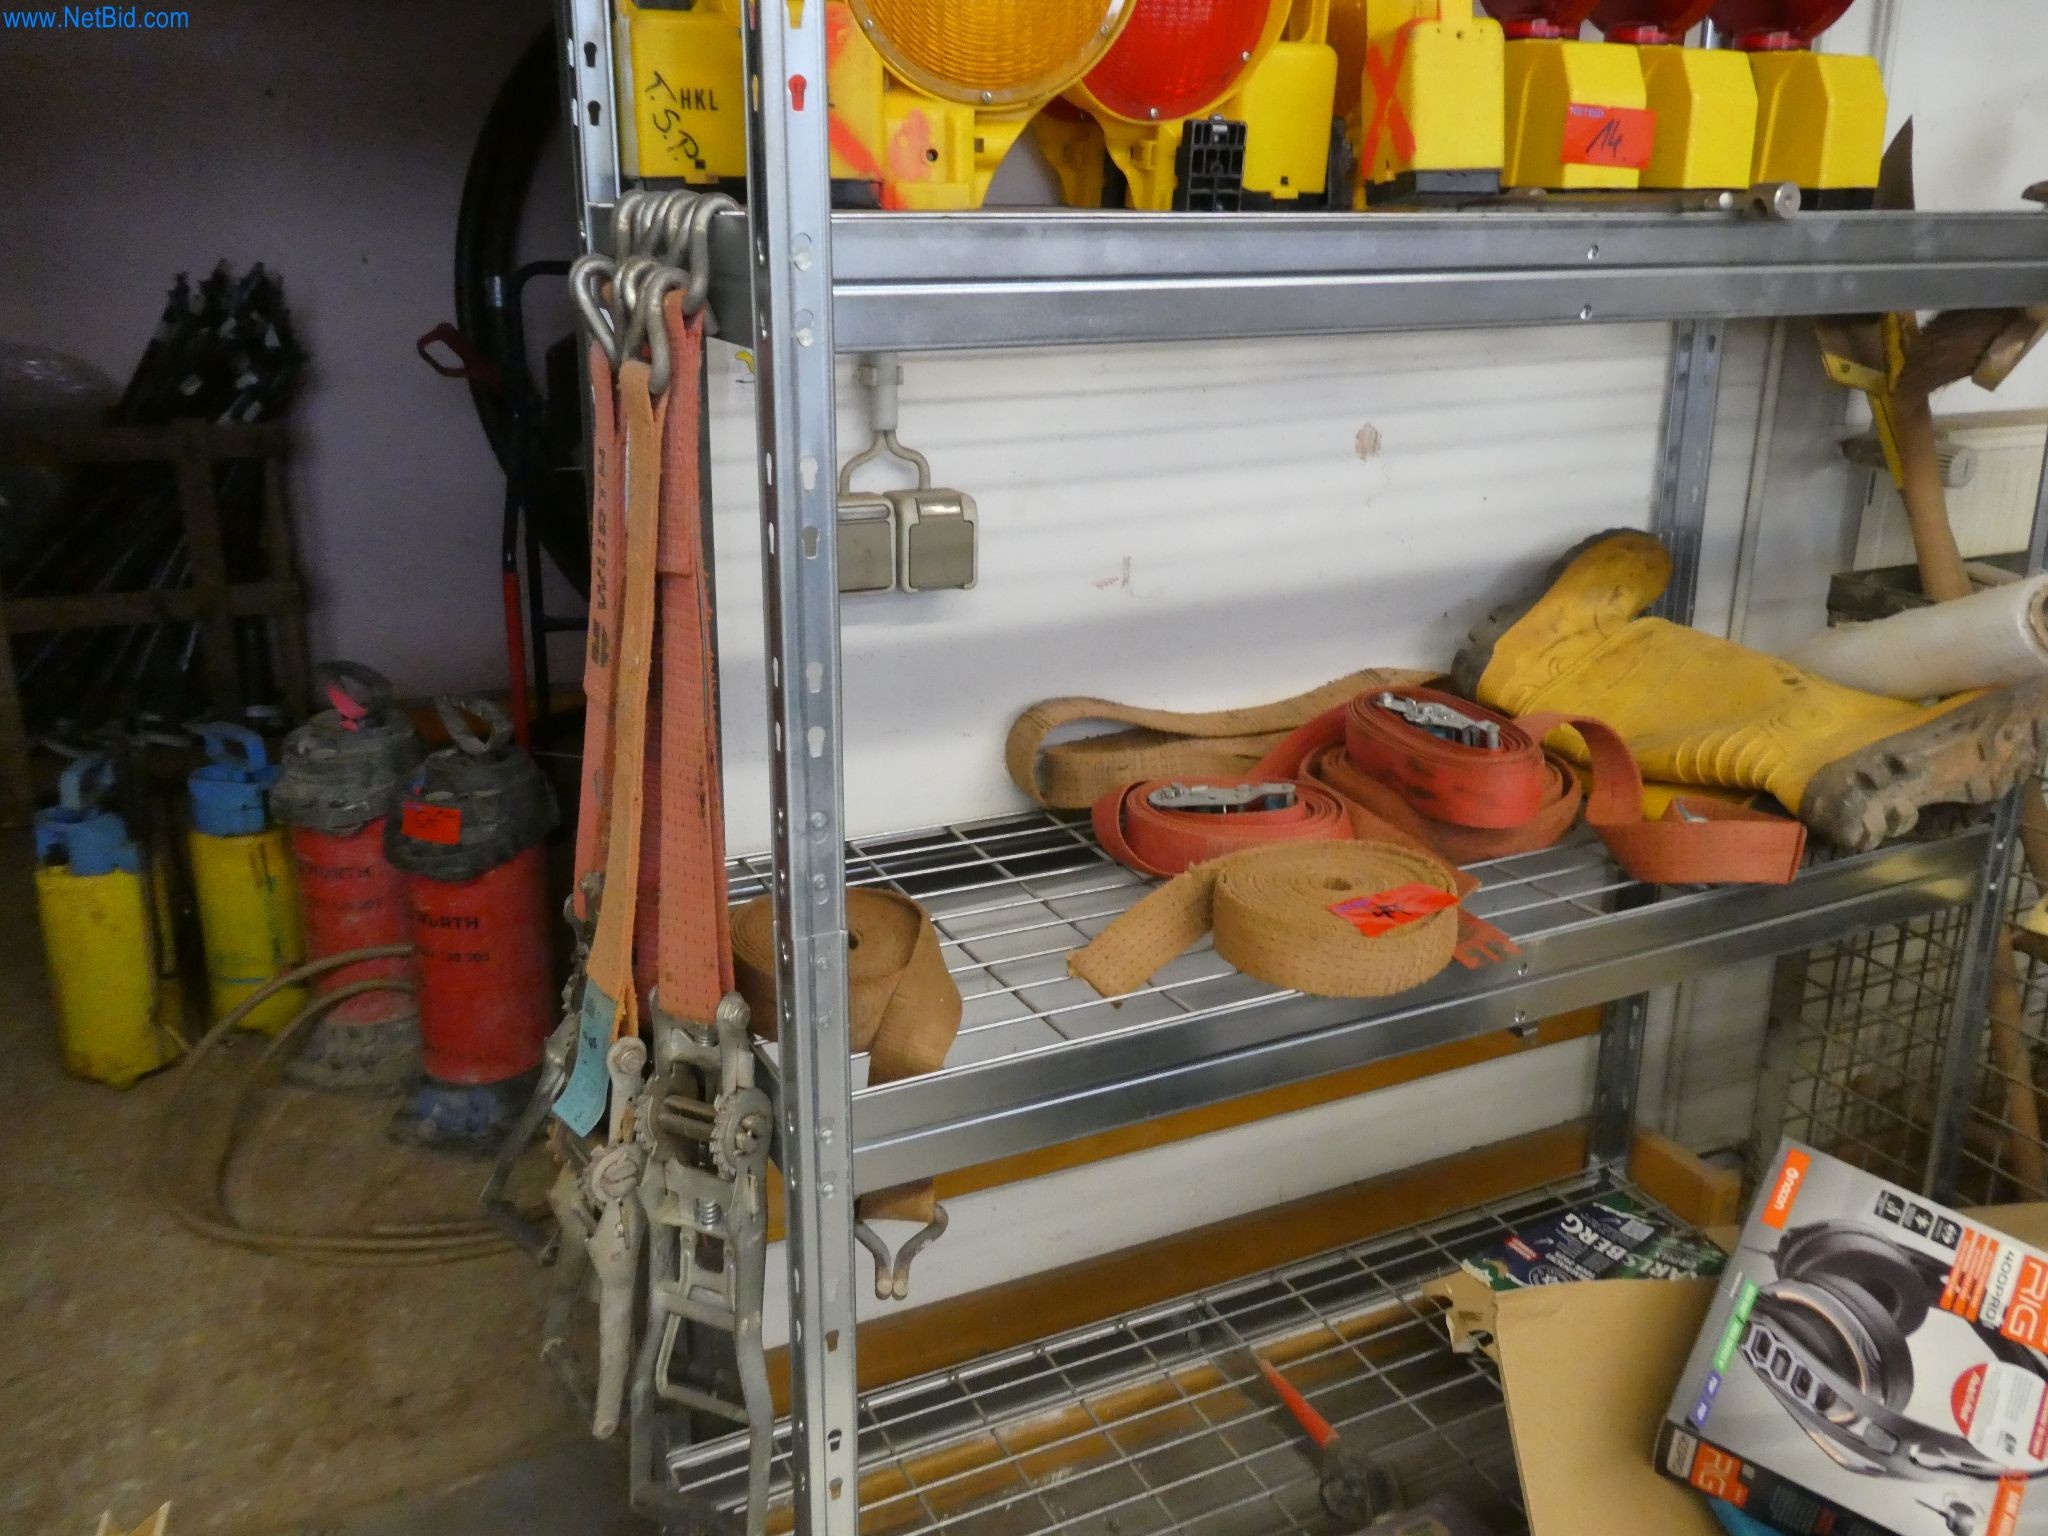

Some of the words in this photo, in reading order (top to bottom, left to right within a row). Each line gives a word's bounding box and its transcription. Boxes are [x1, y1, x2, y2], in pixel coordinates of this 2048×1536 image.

[680, 88, 719, 111] HKL
[1561, 1212, 1699, 1281] ARLSBERG
[1985, 1249, 2016, 1321] 400PRO
[2008, 1260, 2048, 1341] RIG
